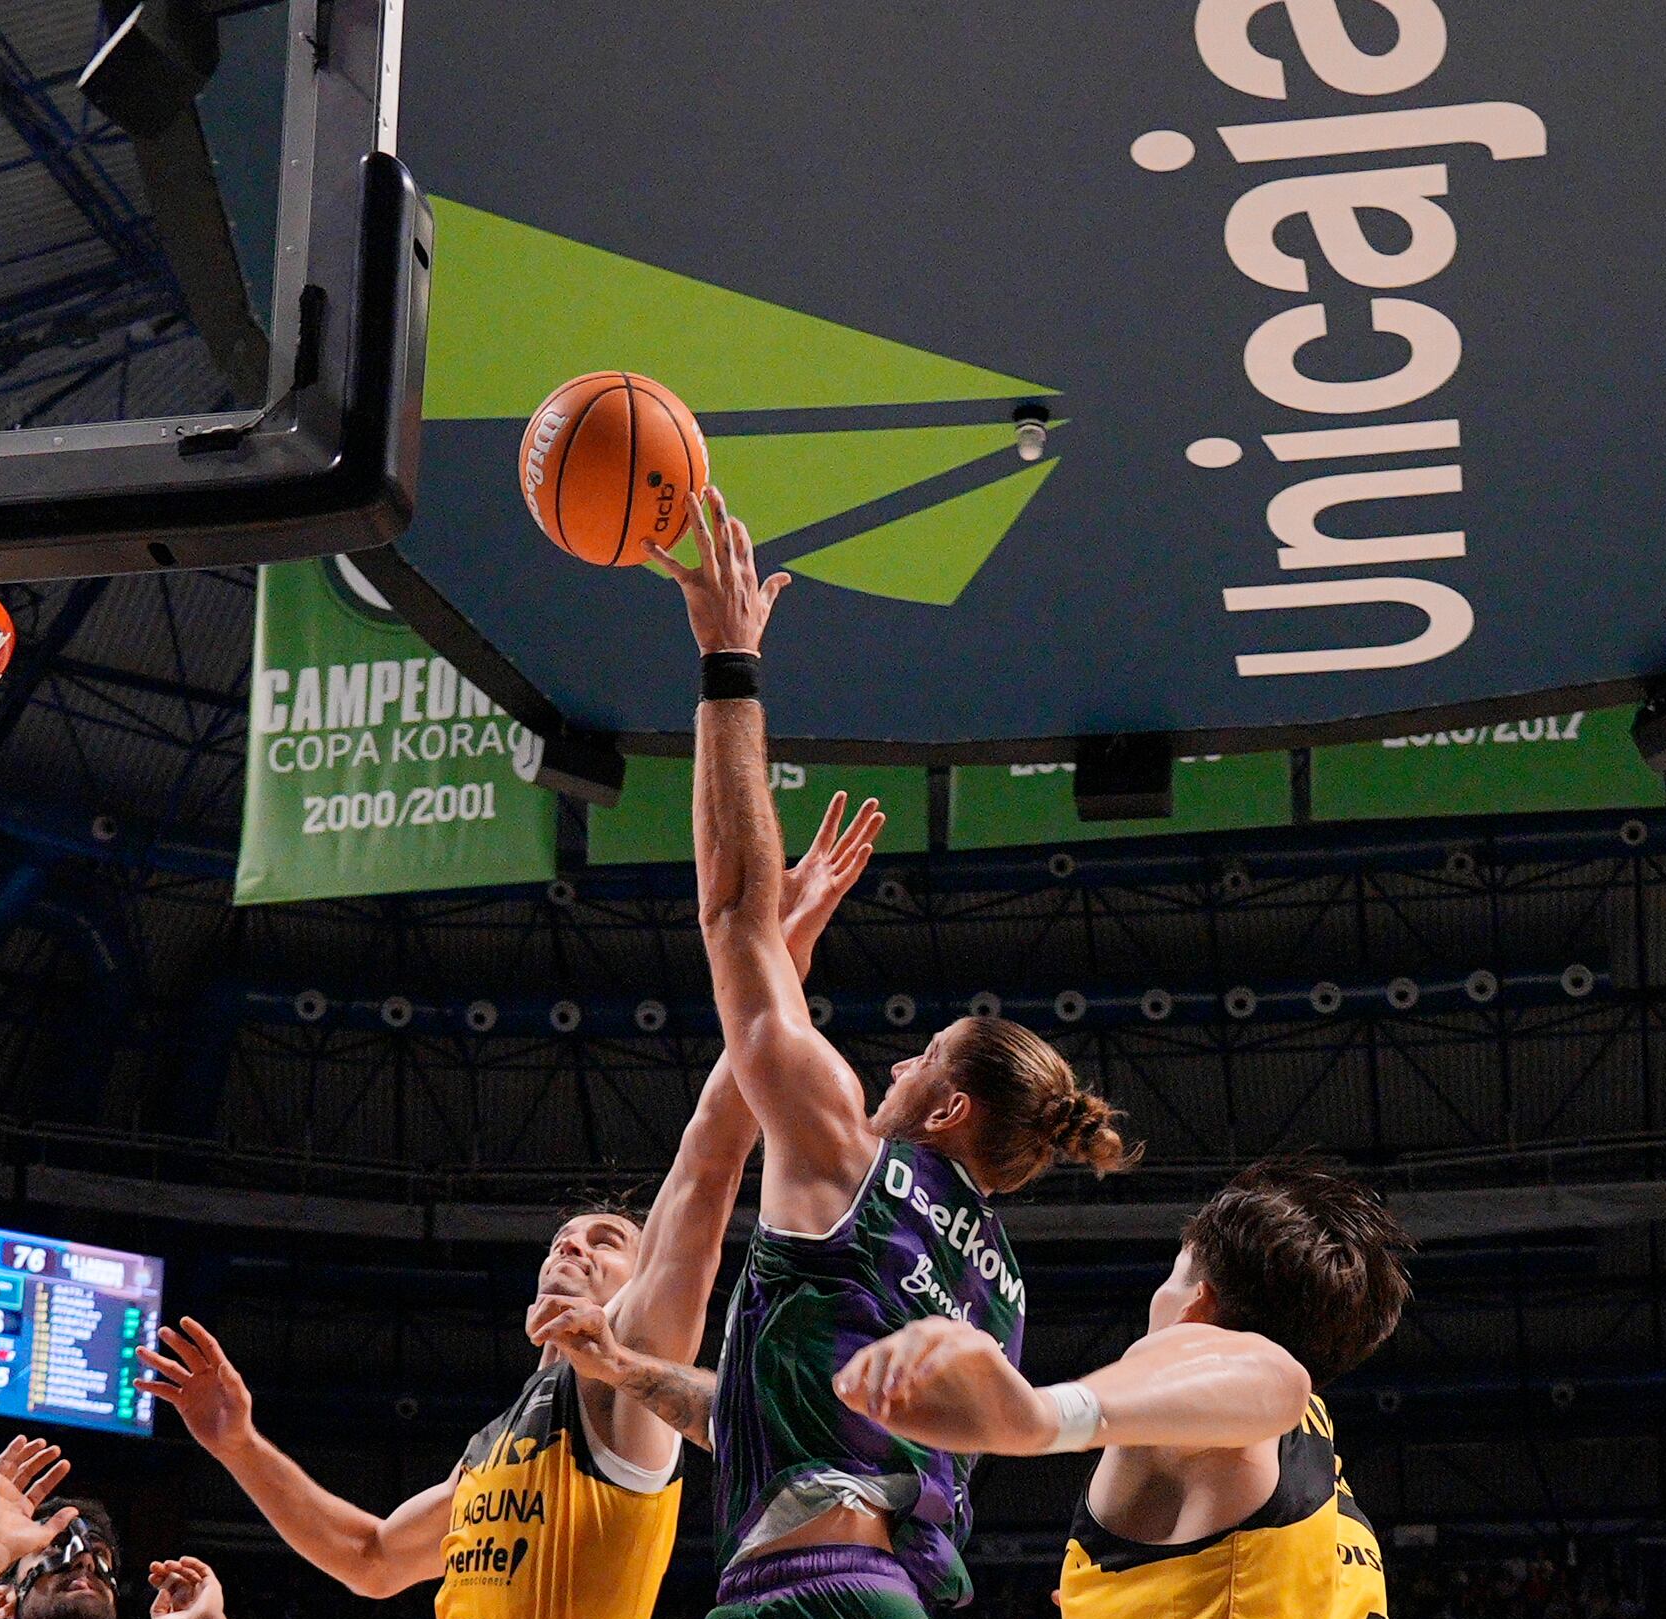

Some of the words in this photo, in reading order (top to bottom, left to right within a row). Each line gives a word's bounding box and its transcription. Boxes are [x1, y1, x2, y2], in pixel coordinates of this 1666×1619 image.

[1130, 0, 1547, 677] Unicaja
[654, 483, 676, 532] acb
[258, 656, 508, 734] CAMPEON
[268, 731, 381, 773] COPA
[302, 781, 495, 834] 2000/2001
[12, 1244, 47, 1273] 76
[451, 1488, 545, 1532] LAGUNA
